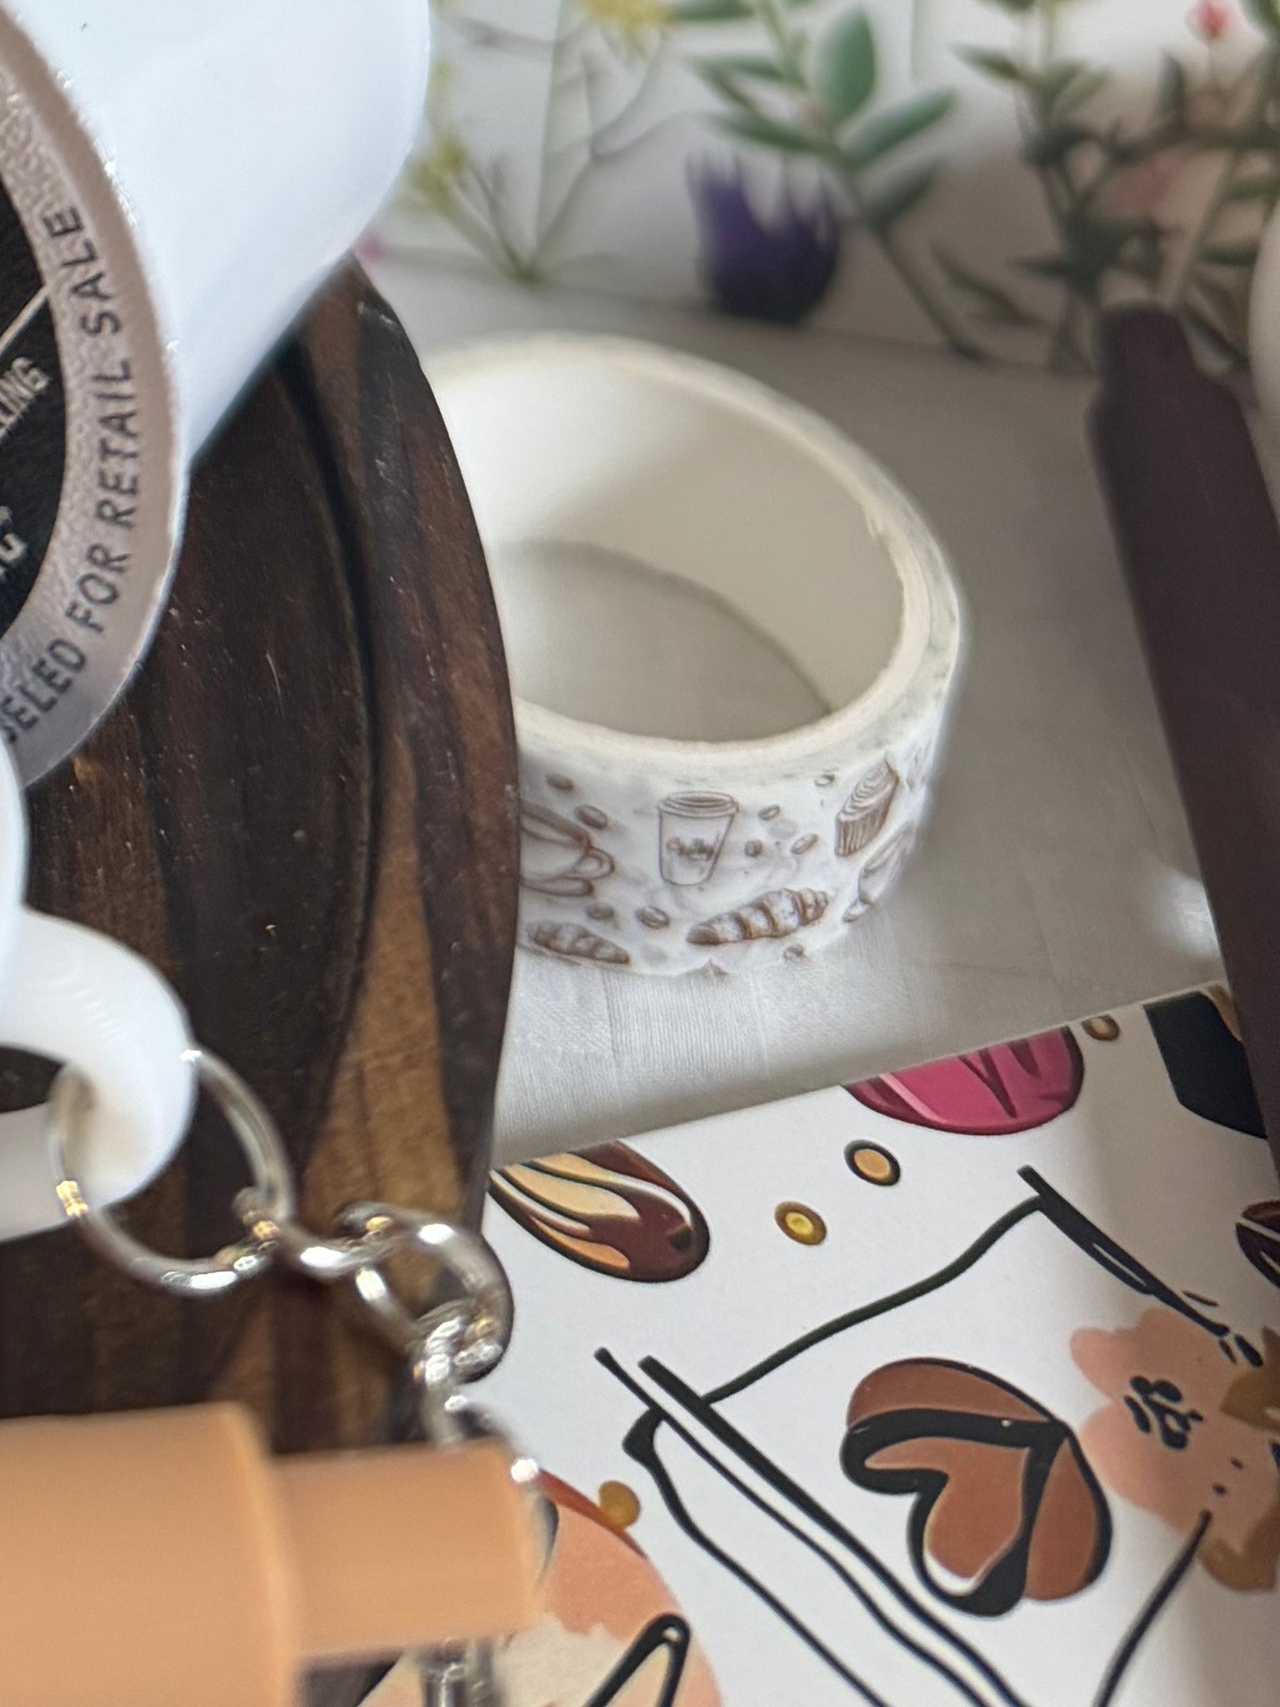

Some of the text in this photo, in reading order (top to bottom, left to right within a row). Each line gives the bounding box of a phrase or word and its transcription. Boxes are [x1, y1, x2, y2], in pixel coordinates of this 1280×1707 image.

[44, 207, 121, 335] SALE
[95, 358, 141, 529] RETAIL
[66, 543, 130, 633] FOR
